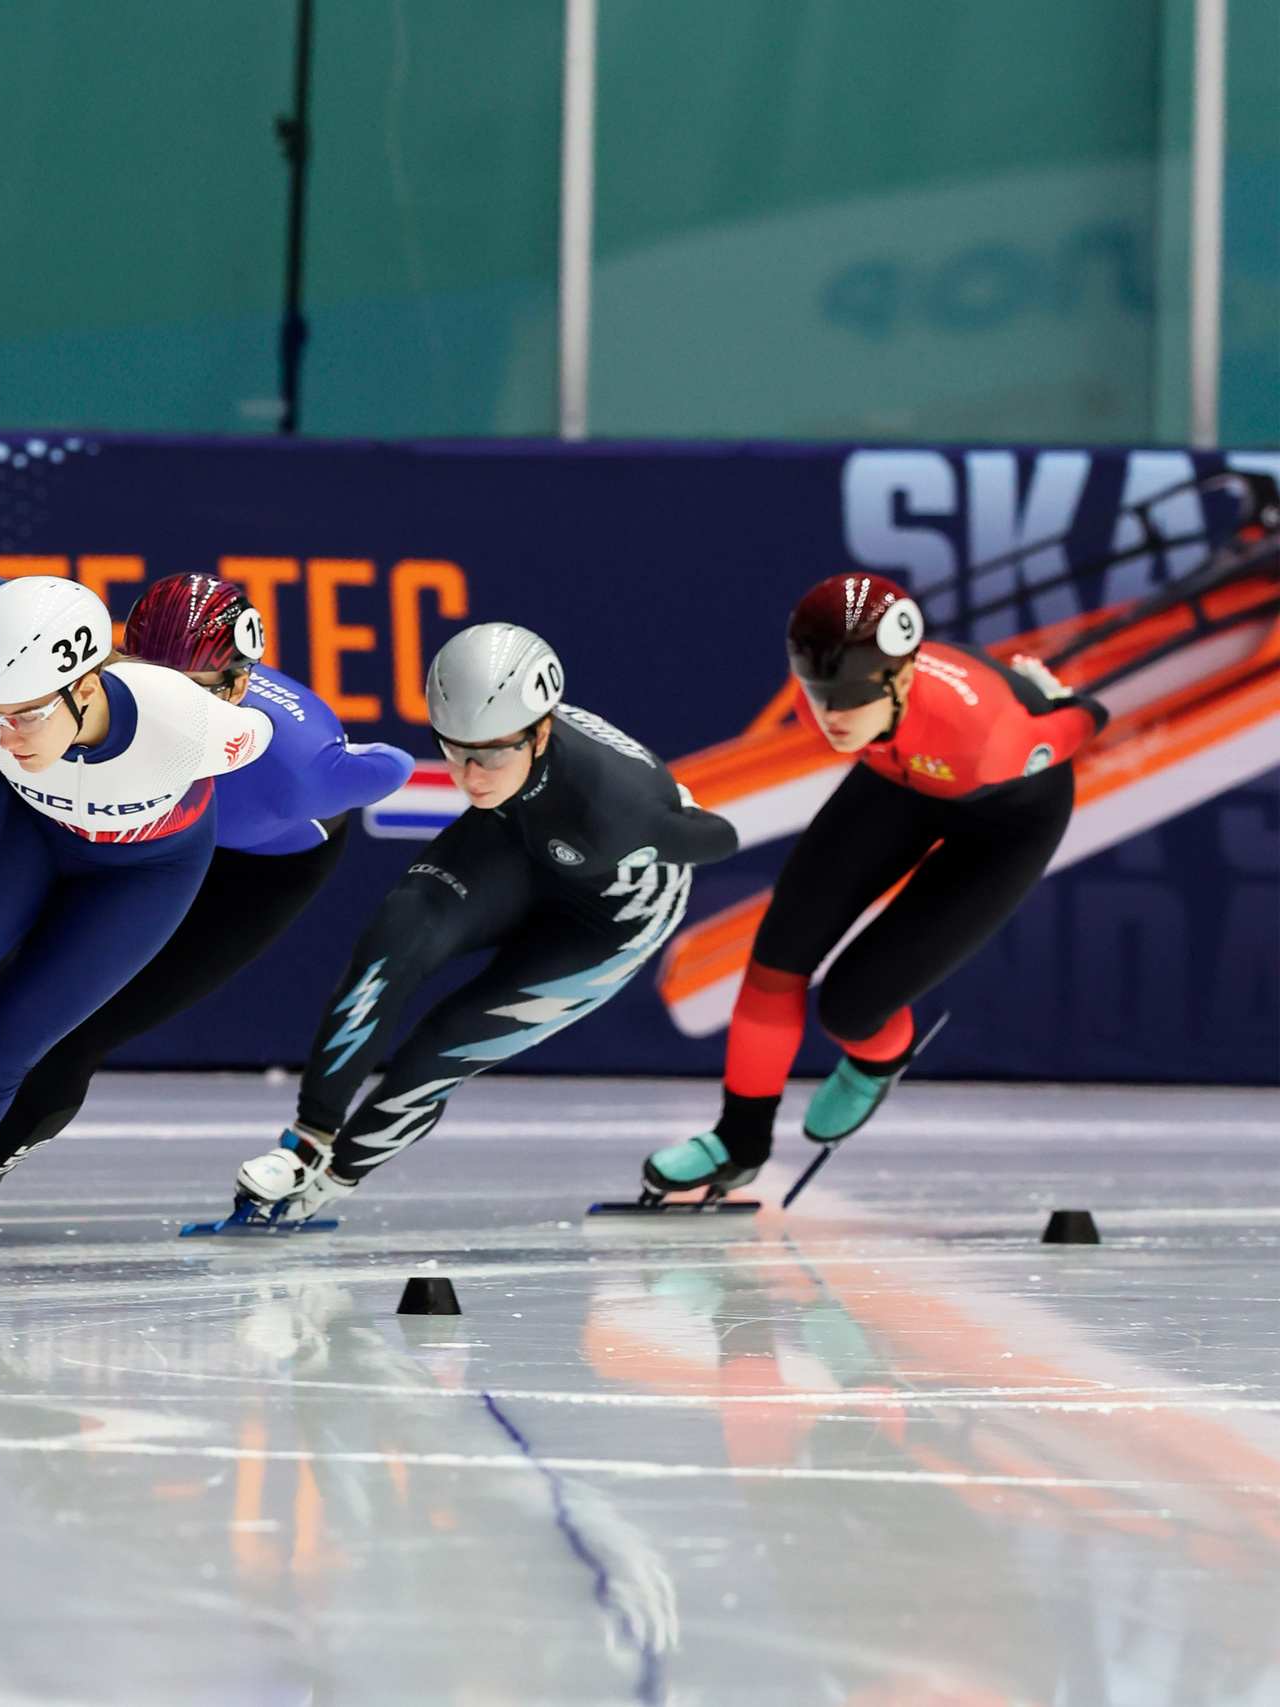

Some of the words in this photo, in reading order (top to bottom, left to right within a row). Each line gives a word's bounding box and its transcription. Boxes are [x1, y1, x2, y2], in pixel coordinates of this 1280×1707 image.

[897, 612, 915, 641] 9
[51, 624, 98, 674] 32
[244, 665, 300, 701] ОБЛА
[534, 661, 562, 701] 10
[247, 681, 306, 723] ЧЕЛЯБ
